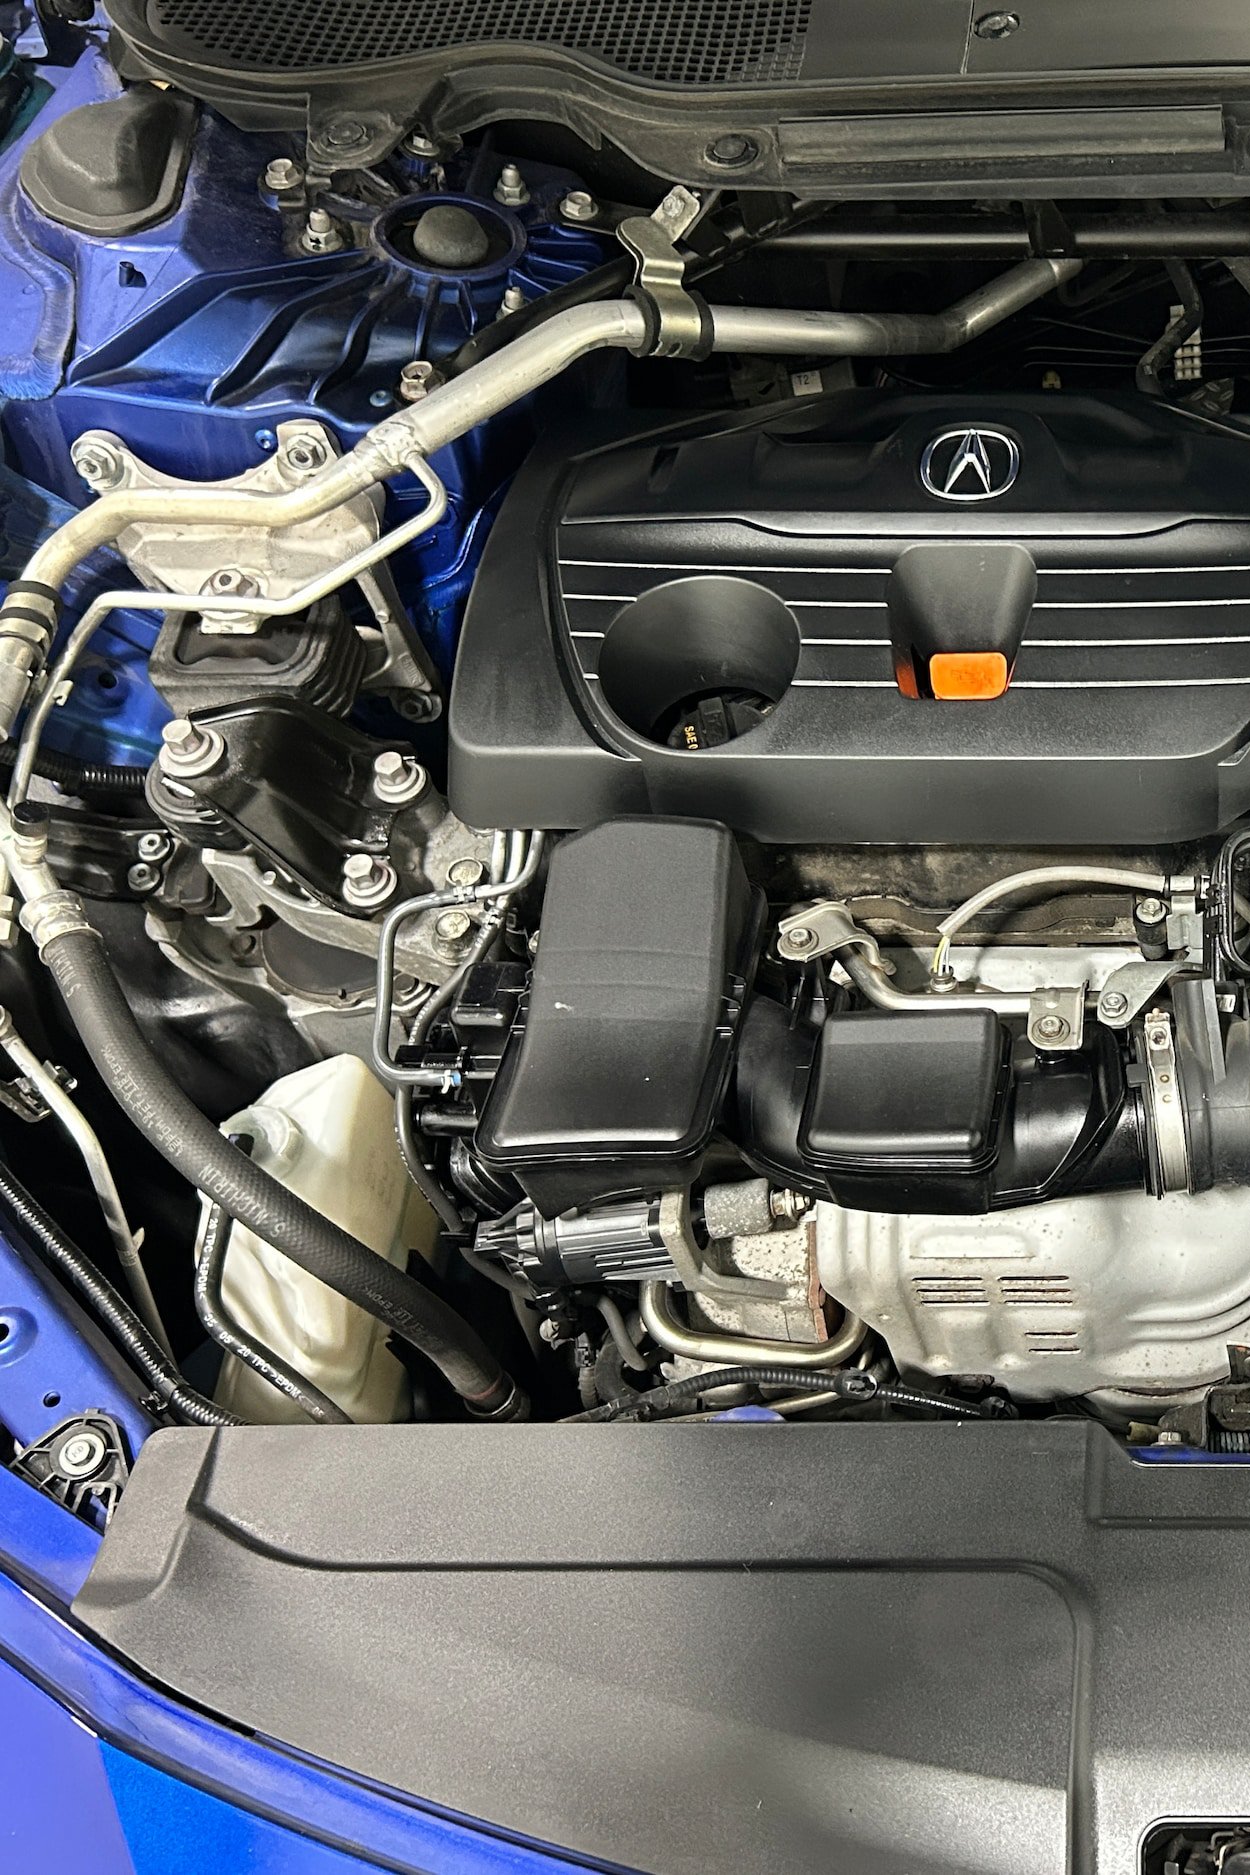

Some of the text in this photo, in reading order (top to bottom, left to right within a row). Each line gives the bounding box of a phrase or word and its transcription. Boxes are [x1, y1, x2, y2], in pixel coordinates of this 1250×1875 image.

[684, 725, 698, 744] SAE
[203, 1234, 217, 1253] TPC
[251, 1354, 271, 1373] TPC
